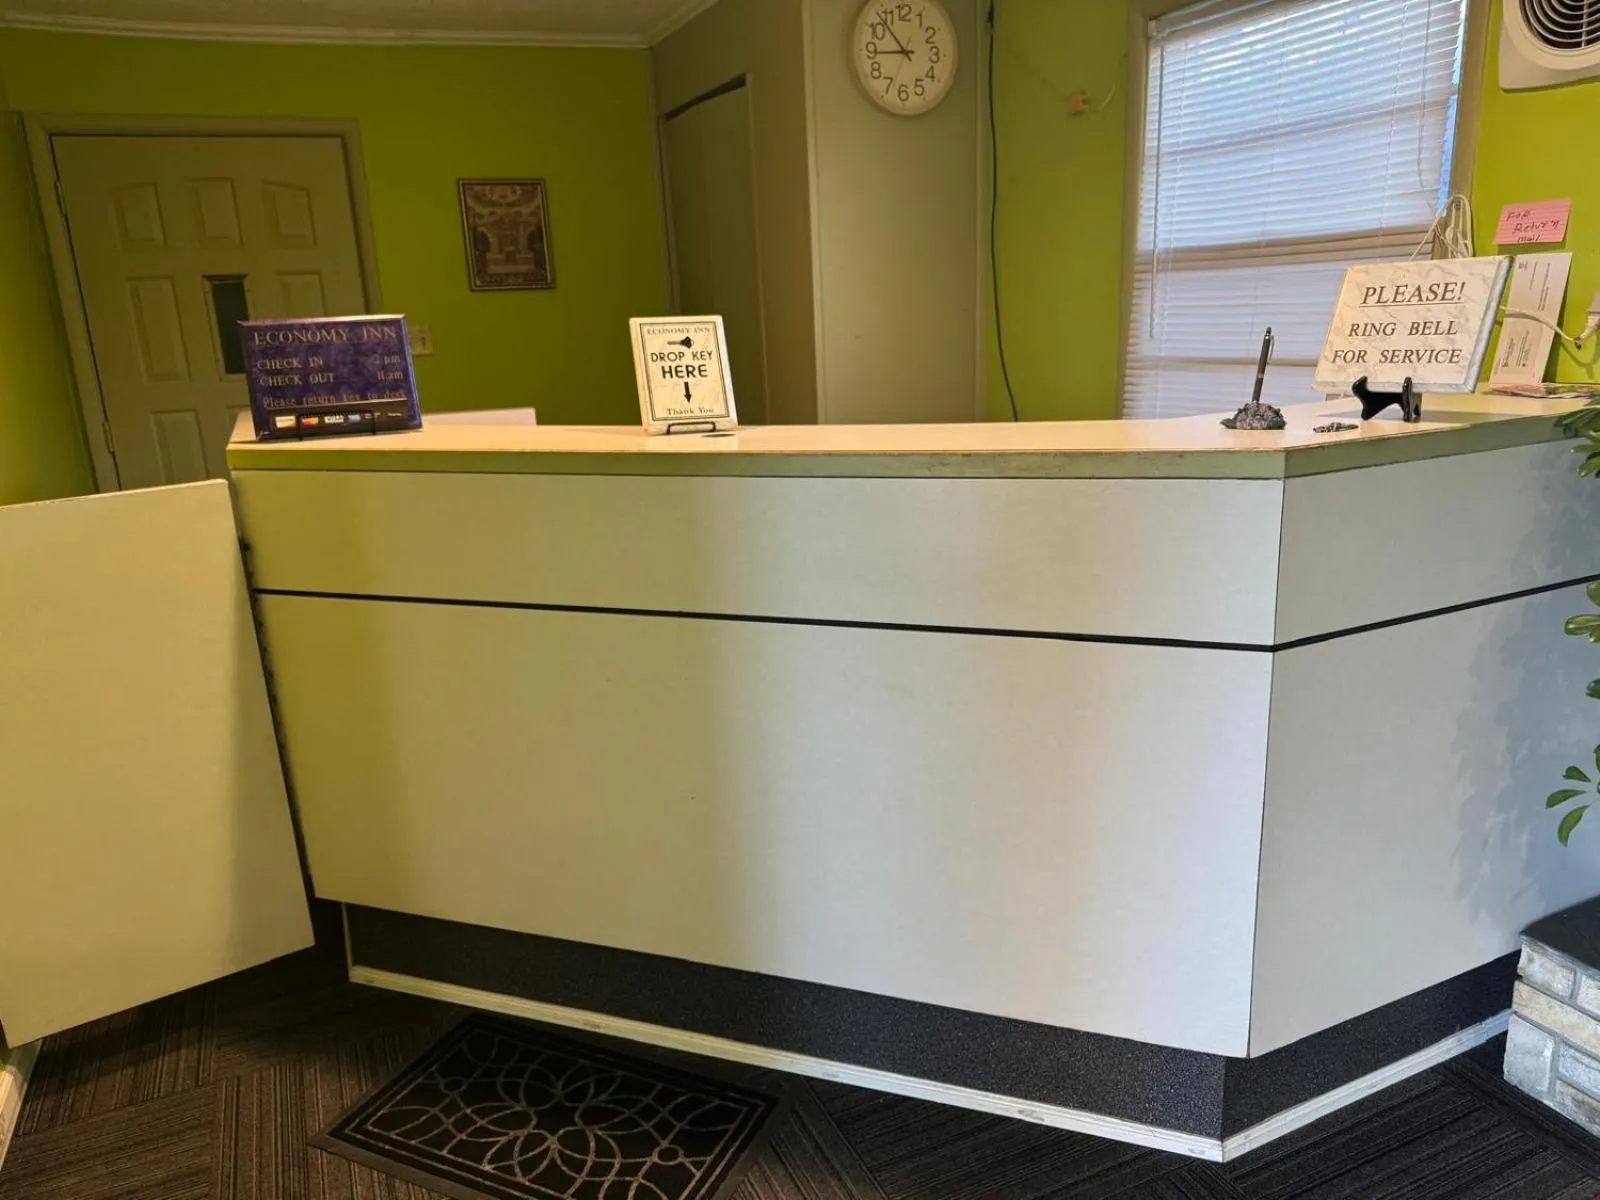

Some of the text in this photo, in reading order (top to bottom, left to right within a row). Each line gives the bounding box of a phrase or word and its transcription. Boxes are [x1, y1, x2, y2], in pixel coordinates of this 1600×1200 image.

[882, 9, 894, 26] 11
[895, 4, 912, 22] 12
[916, 12, 923, 28] 1
[866, 22, 886, 41] 10
[925, 26, 936, 45] 2
[866, 41, 877, 60] 9
[929, 46, 940, 64] 3
[870, 61, 882, 80] 8
[925, 66, 936, 83] 4
[883, 77, 894, 94] 7
[898, 84, 910, 102] 6
[914, 79, 925, 97] 5
[1361, 282, 1466, 305] PLEASE!
[254, 325, 397, 346] ECONOMY INN
[647, 327, 690, 335] ECONOMY
[1348, 320, 1458, 337] RING BELL
[257, 357, 302, 370] CHECK
[309, 356, 323, 368] IN
[650, 350, 713, 363] DROP KEY
[1332, 348, 1463, 364] FOR SERVICE
[260, 374, 302, 387] CHECK
[309, 372, 335, 384] OUT
[661, 364, 709, 379] HERE
[263, 396, 297, 408] Please
[699, 406, 714, 414] You
